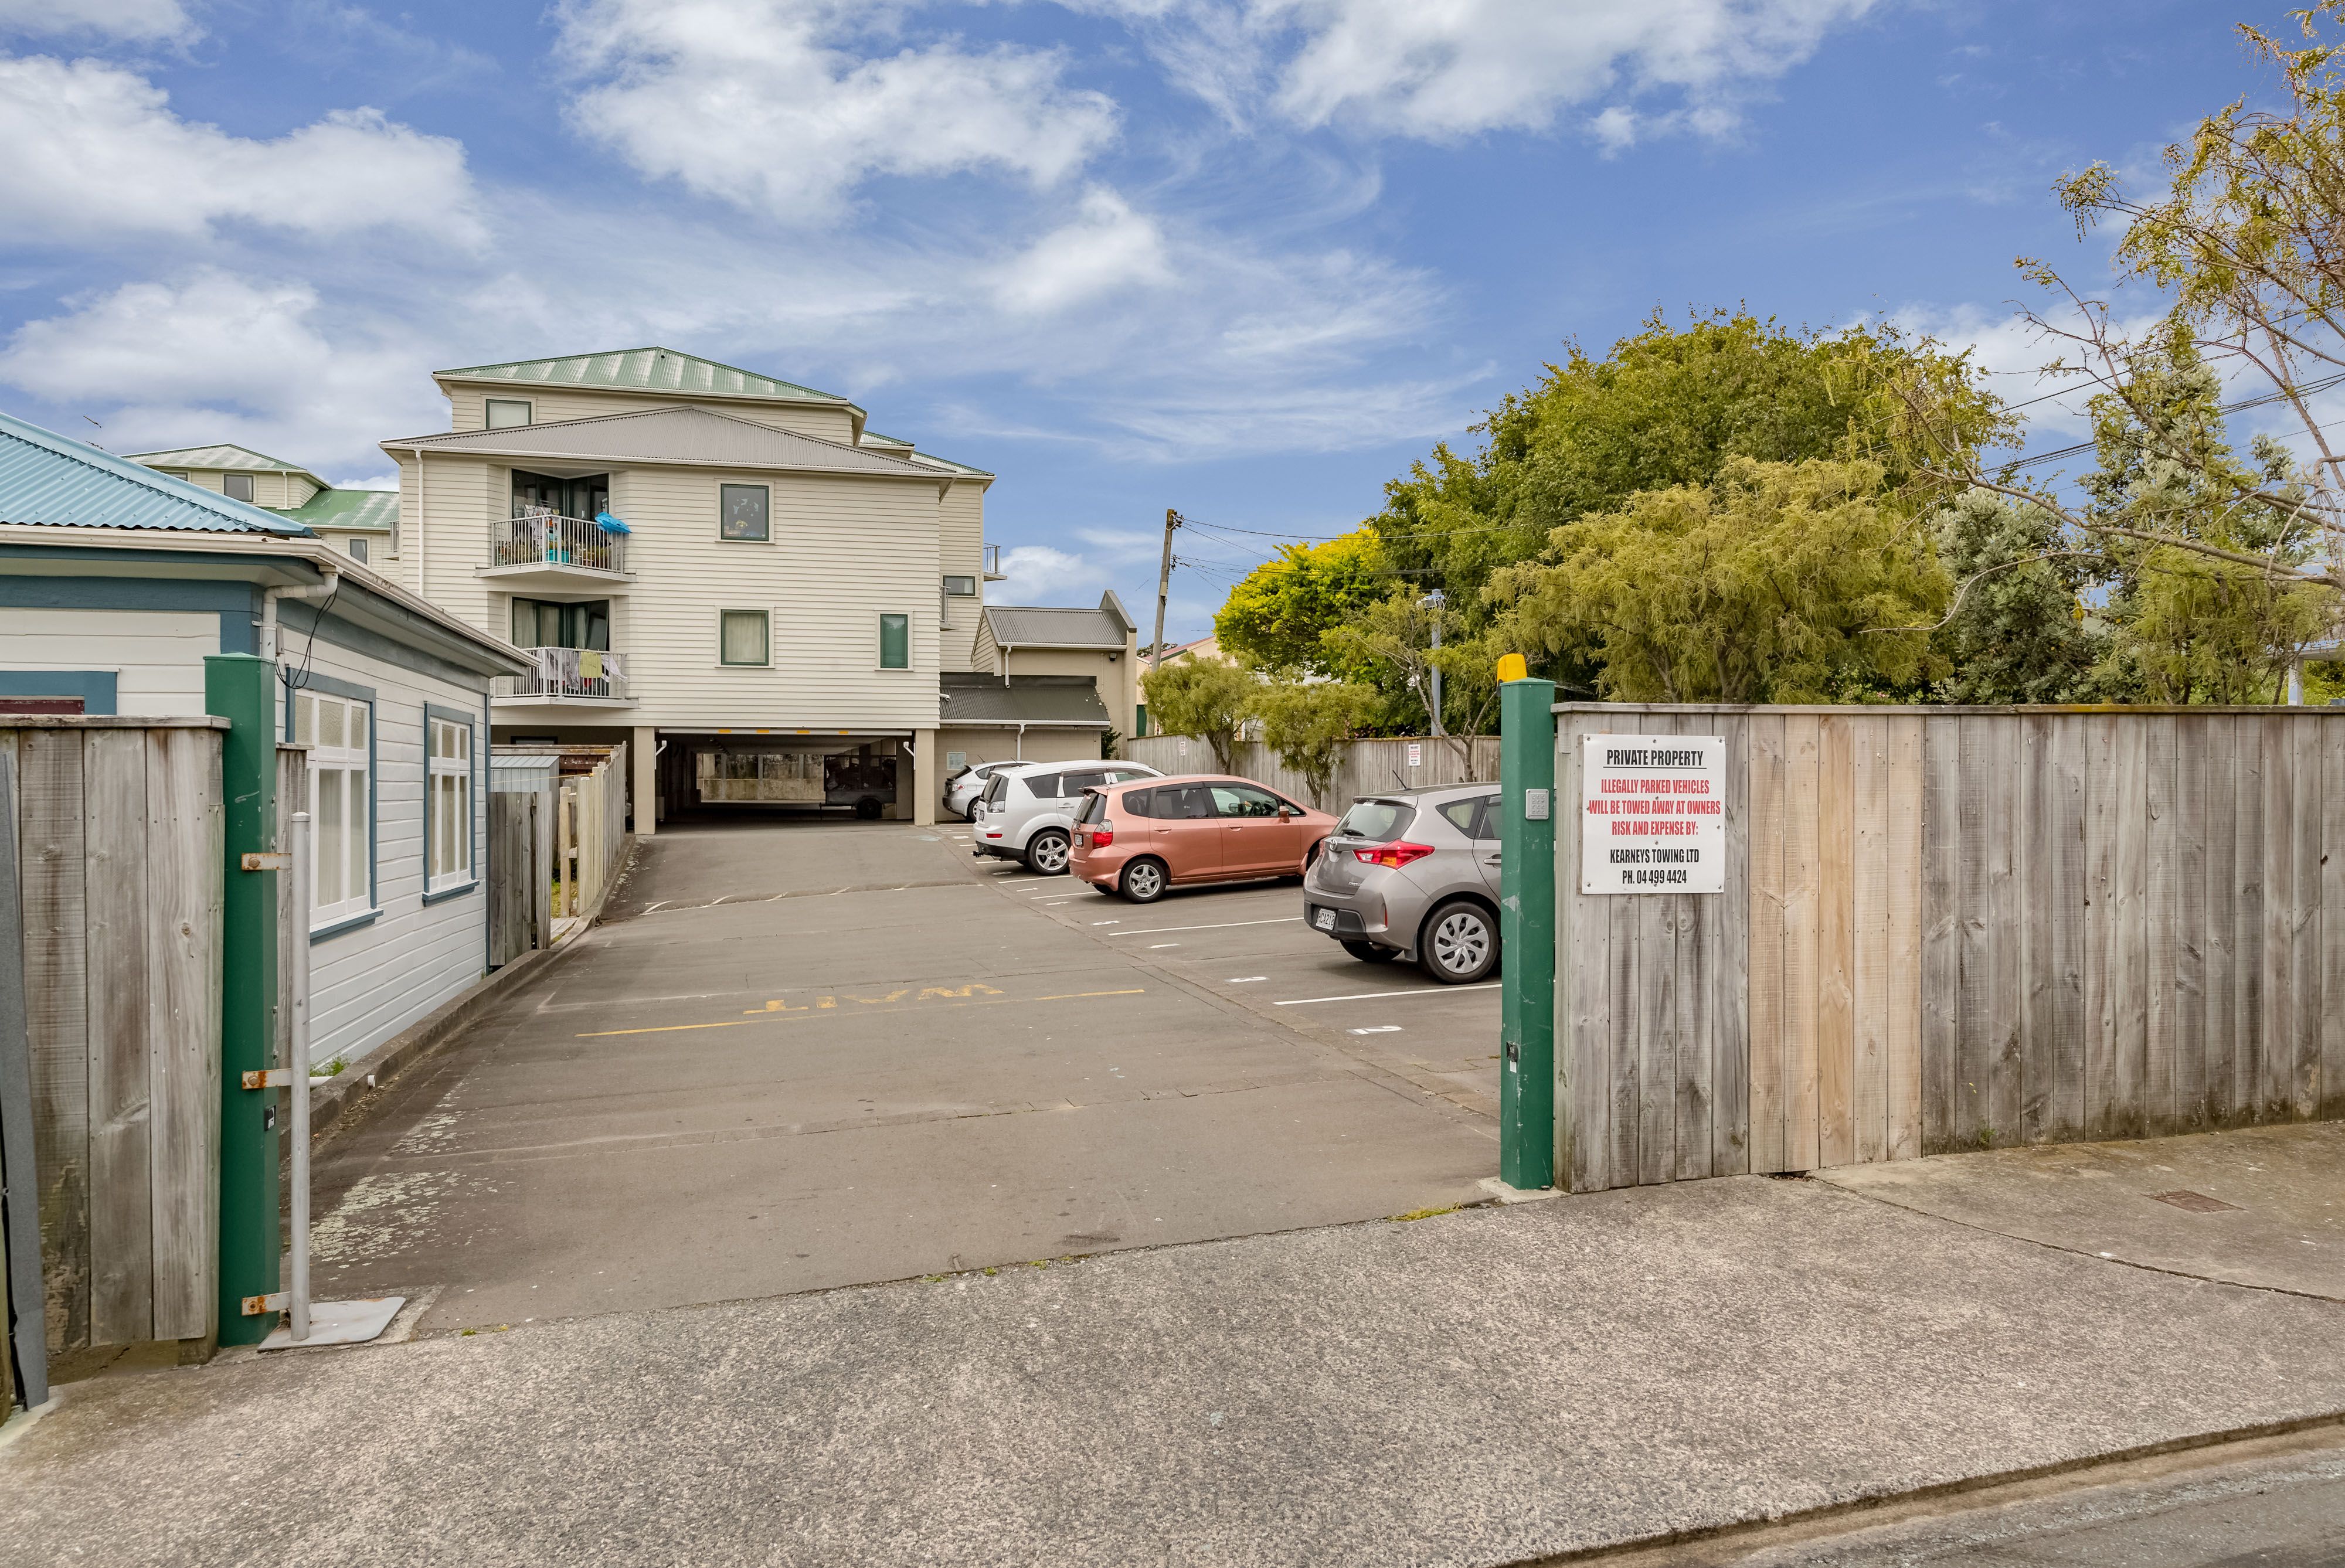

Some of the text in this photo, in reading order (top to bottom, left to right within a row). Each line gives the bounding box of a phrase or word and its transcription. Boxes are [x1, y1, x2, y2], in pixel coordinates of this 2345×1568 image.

[1607, 750, 1703, 766] PRIVATE PROPERTY
[1601, 779, 1710, 794] ILLEGALLY PARKED VEHICLES
[1589, 800, 1720, 815] WILL BE TOWED AWAY AT OWNERS
[1612, 821, 1698, 835] RISK AND EXPENSE BY:
[1610, 849, 1699, 863] KEARNEYS TOWING LTD
[1622, 869, 1687, 884] PH. 04 499 4424
